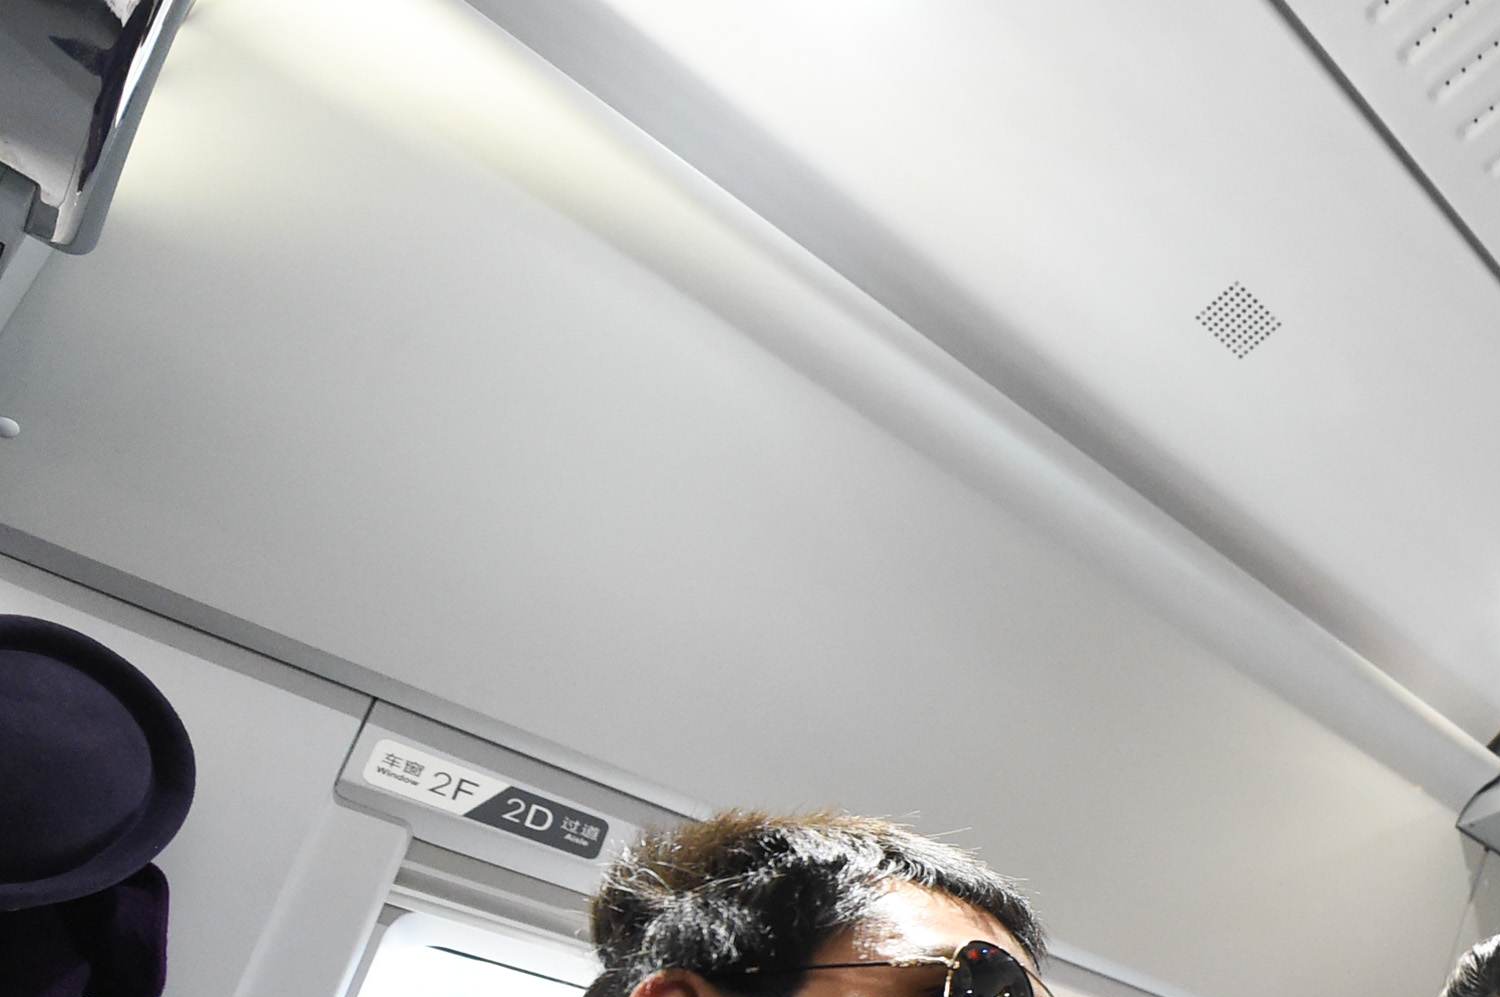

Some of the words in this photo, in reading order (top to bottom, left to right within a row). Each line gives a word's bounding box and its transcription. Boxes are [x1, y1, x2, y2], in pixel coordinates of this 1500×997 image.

[376, 765, 420, 786] Window
[382, 752, 425, 777] 车窗
[427, 771, 480, 800] 2F
[501, 797, 554, 831] 2D
[560, 815, 601, 842] 过道
